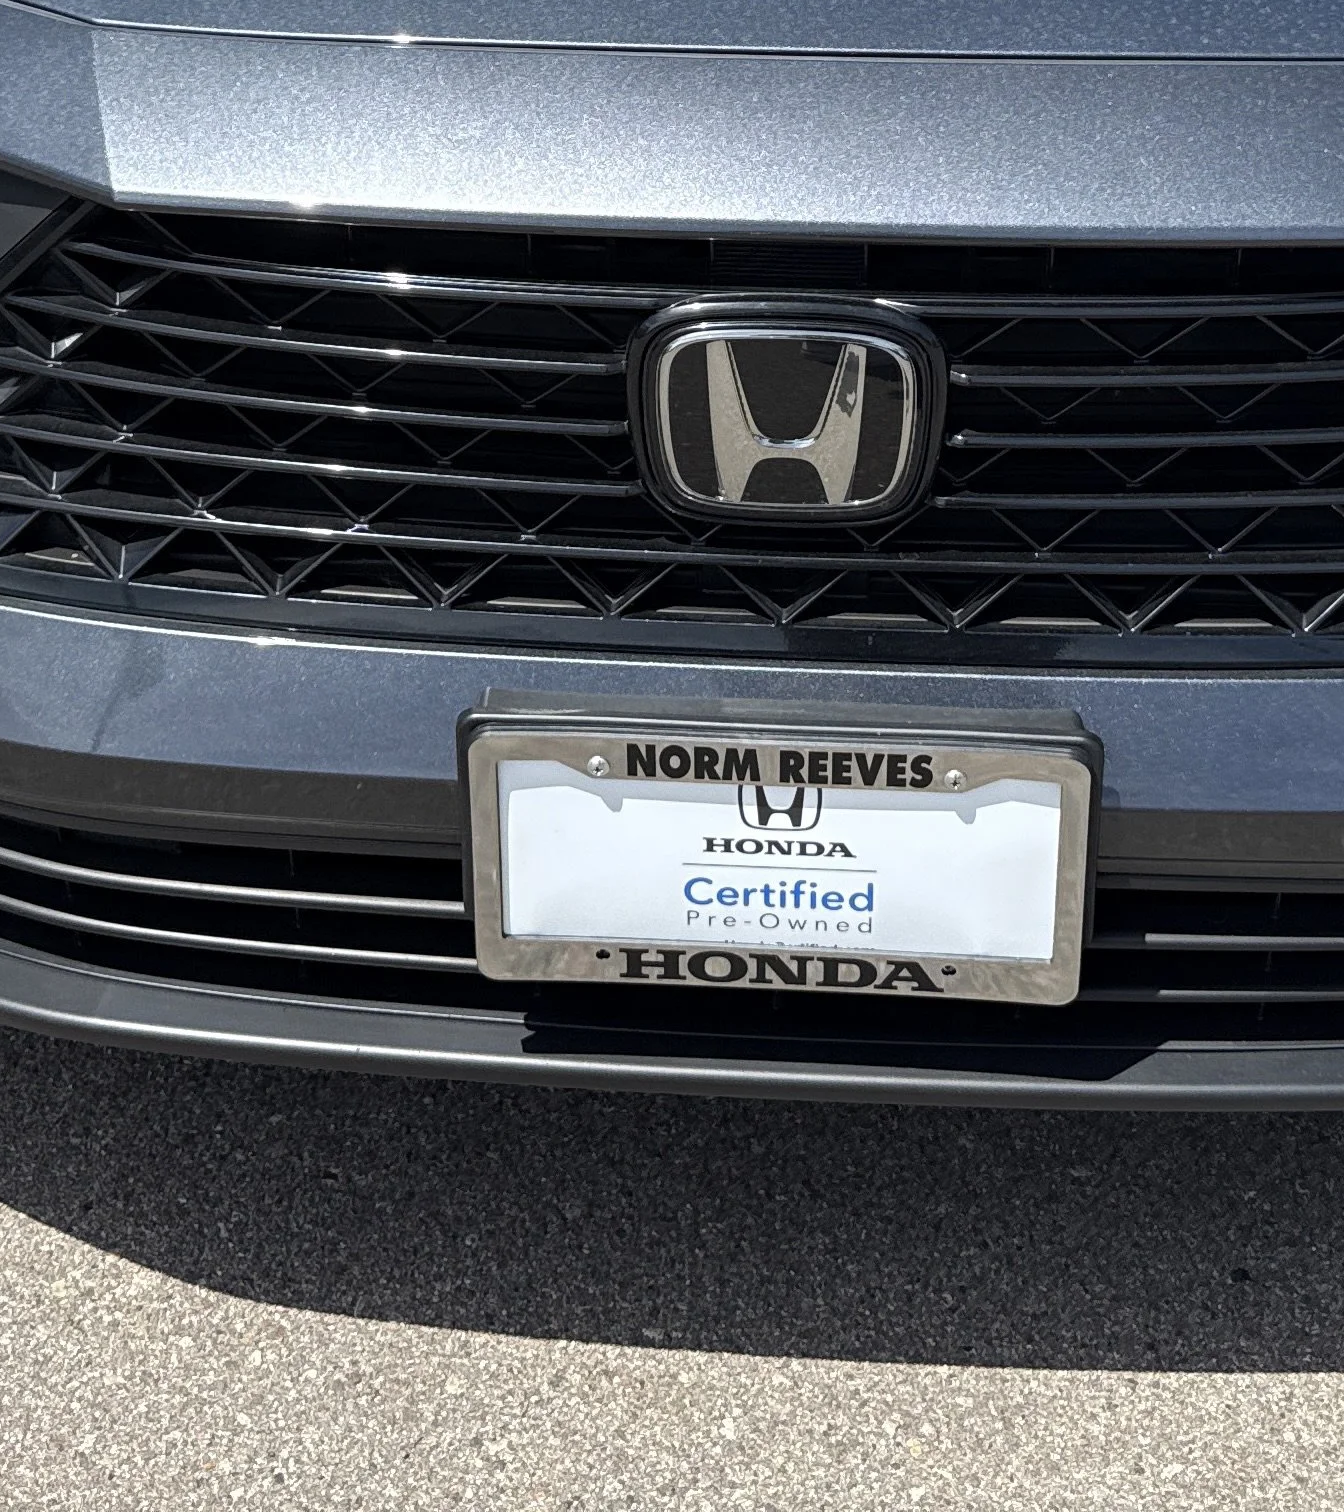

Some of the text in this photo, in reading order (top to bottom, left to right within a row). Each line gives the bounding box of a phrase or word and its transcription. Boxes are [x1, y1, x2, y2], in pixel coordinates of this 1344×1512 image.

[626, 743, 934, 788] NORM REEVES
[702, 836, 857, 859] HONDA
[683, 876, 875, 913] Certified
[686, 909, 873, 934] Pre-Owned
[618, 947, 945, 993] HONDA
